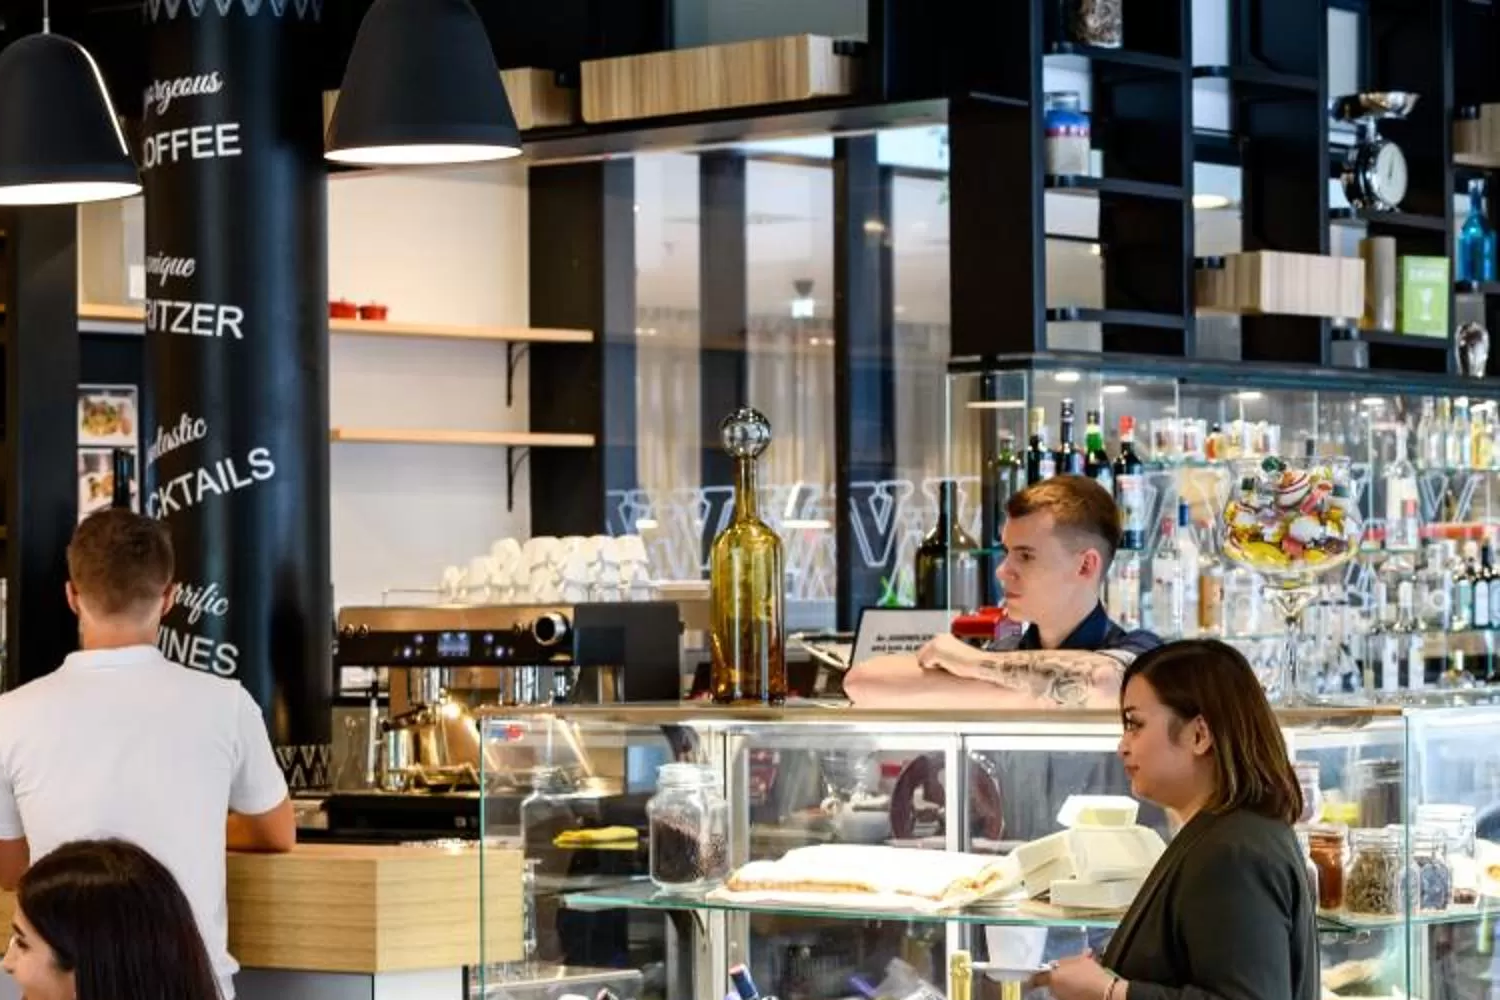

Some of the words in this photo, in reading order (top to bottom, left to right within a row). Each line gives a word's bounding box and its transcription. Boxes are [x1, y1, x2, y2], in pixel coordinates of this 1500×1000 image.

[143, 122, 242, 168] OFFEE
[147, 447, 276, 520] CKTAILS
[158, 625, 239, 676] INES
